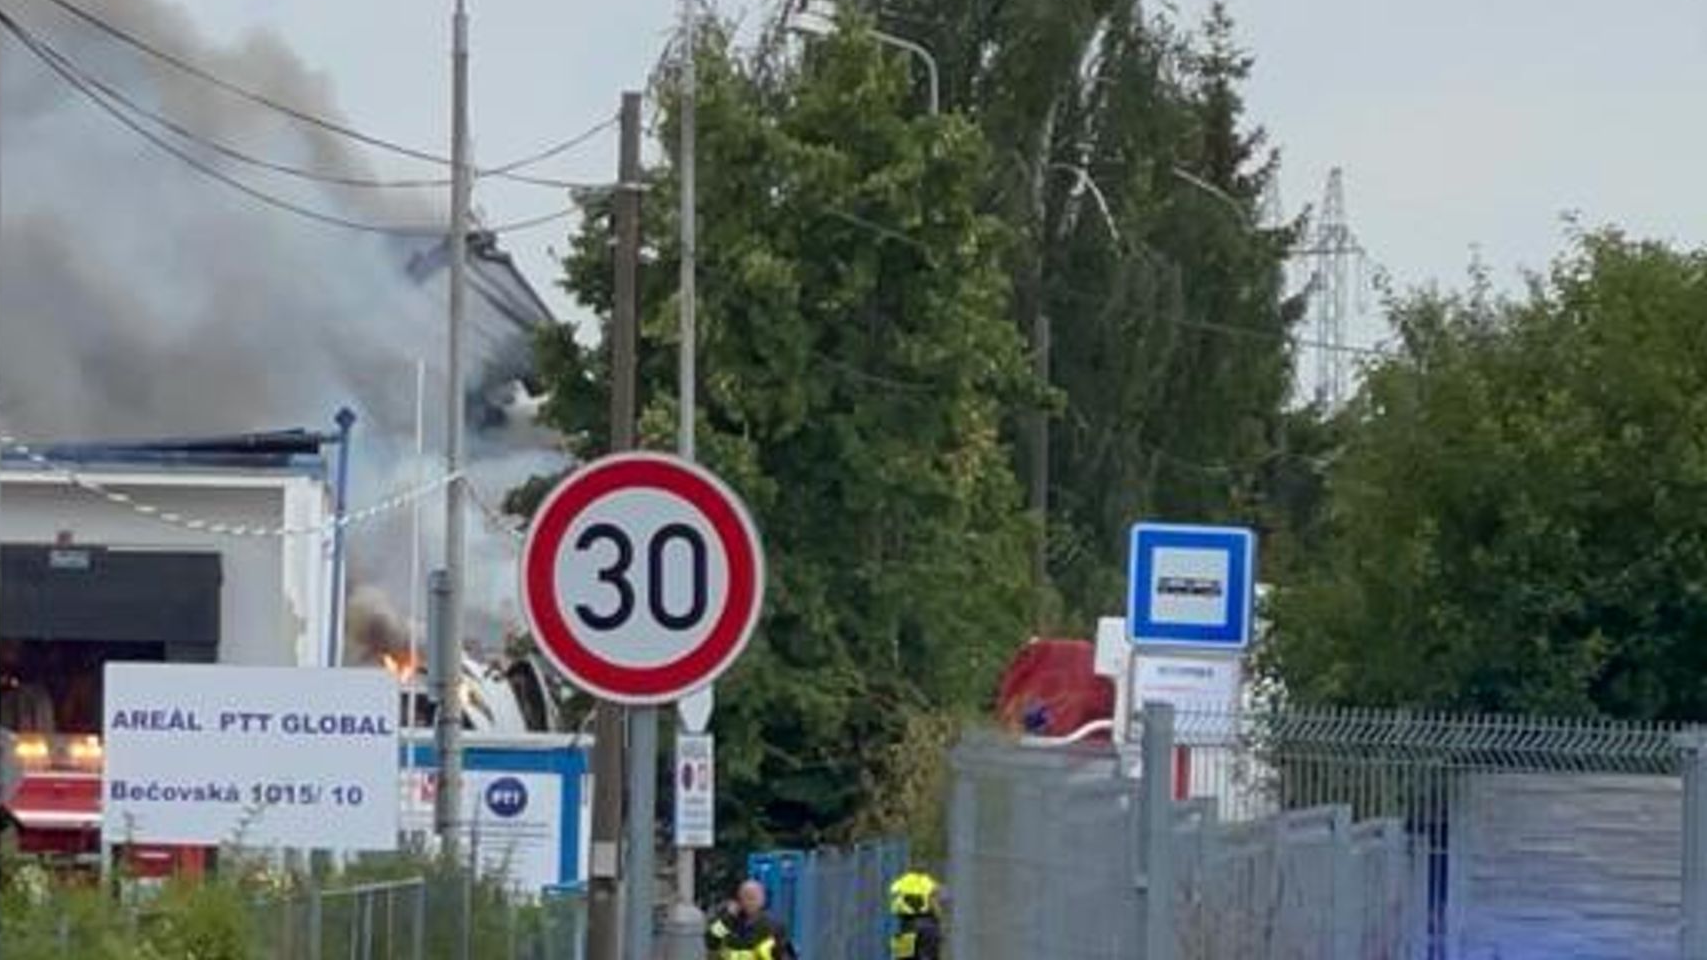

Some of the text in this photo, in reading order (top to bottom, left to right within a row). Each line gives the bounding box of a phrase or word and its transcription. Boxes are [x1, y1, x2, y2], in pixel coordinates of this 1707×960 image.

[575, 523, 708, 631] 30
[111, 706, 393, 735] AREÁL PTT GLOBAL
[110, 780, 239, 802] Bečovská
